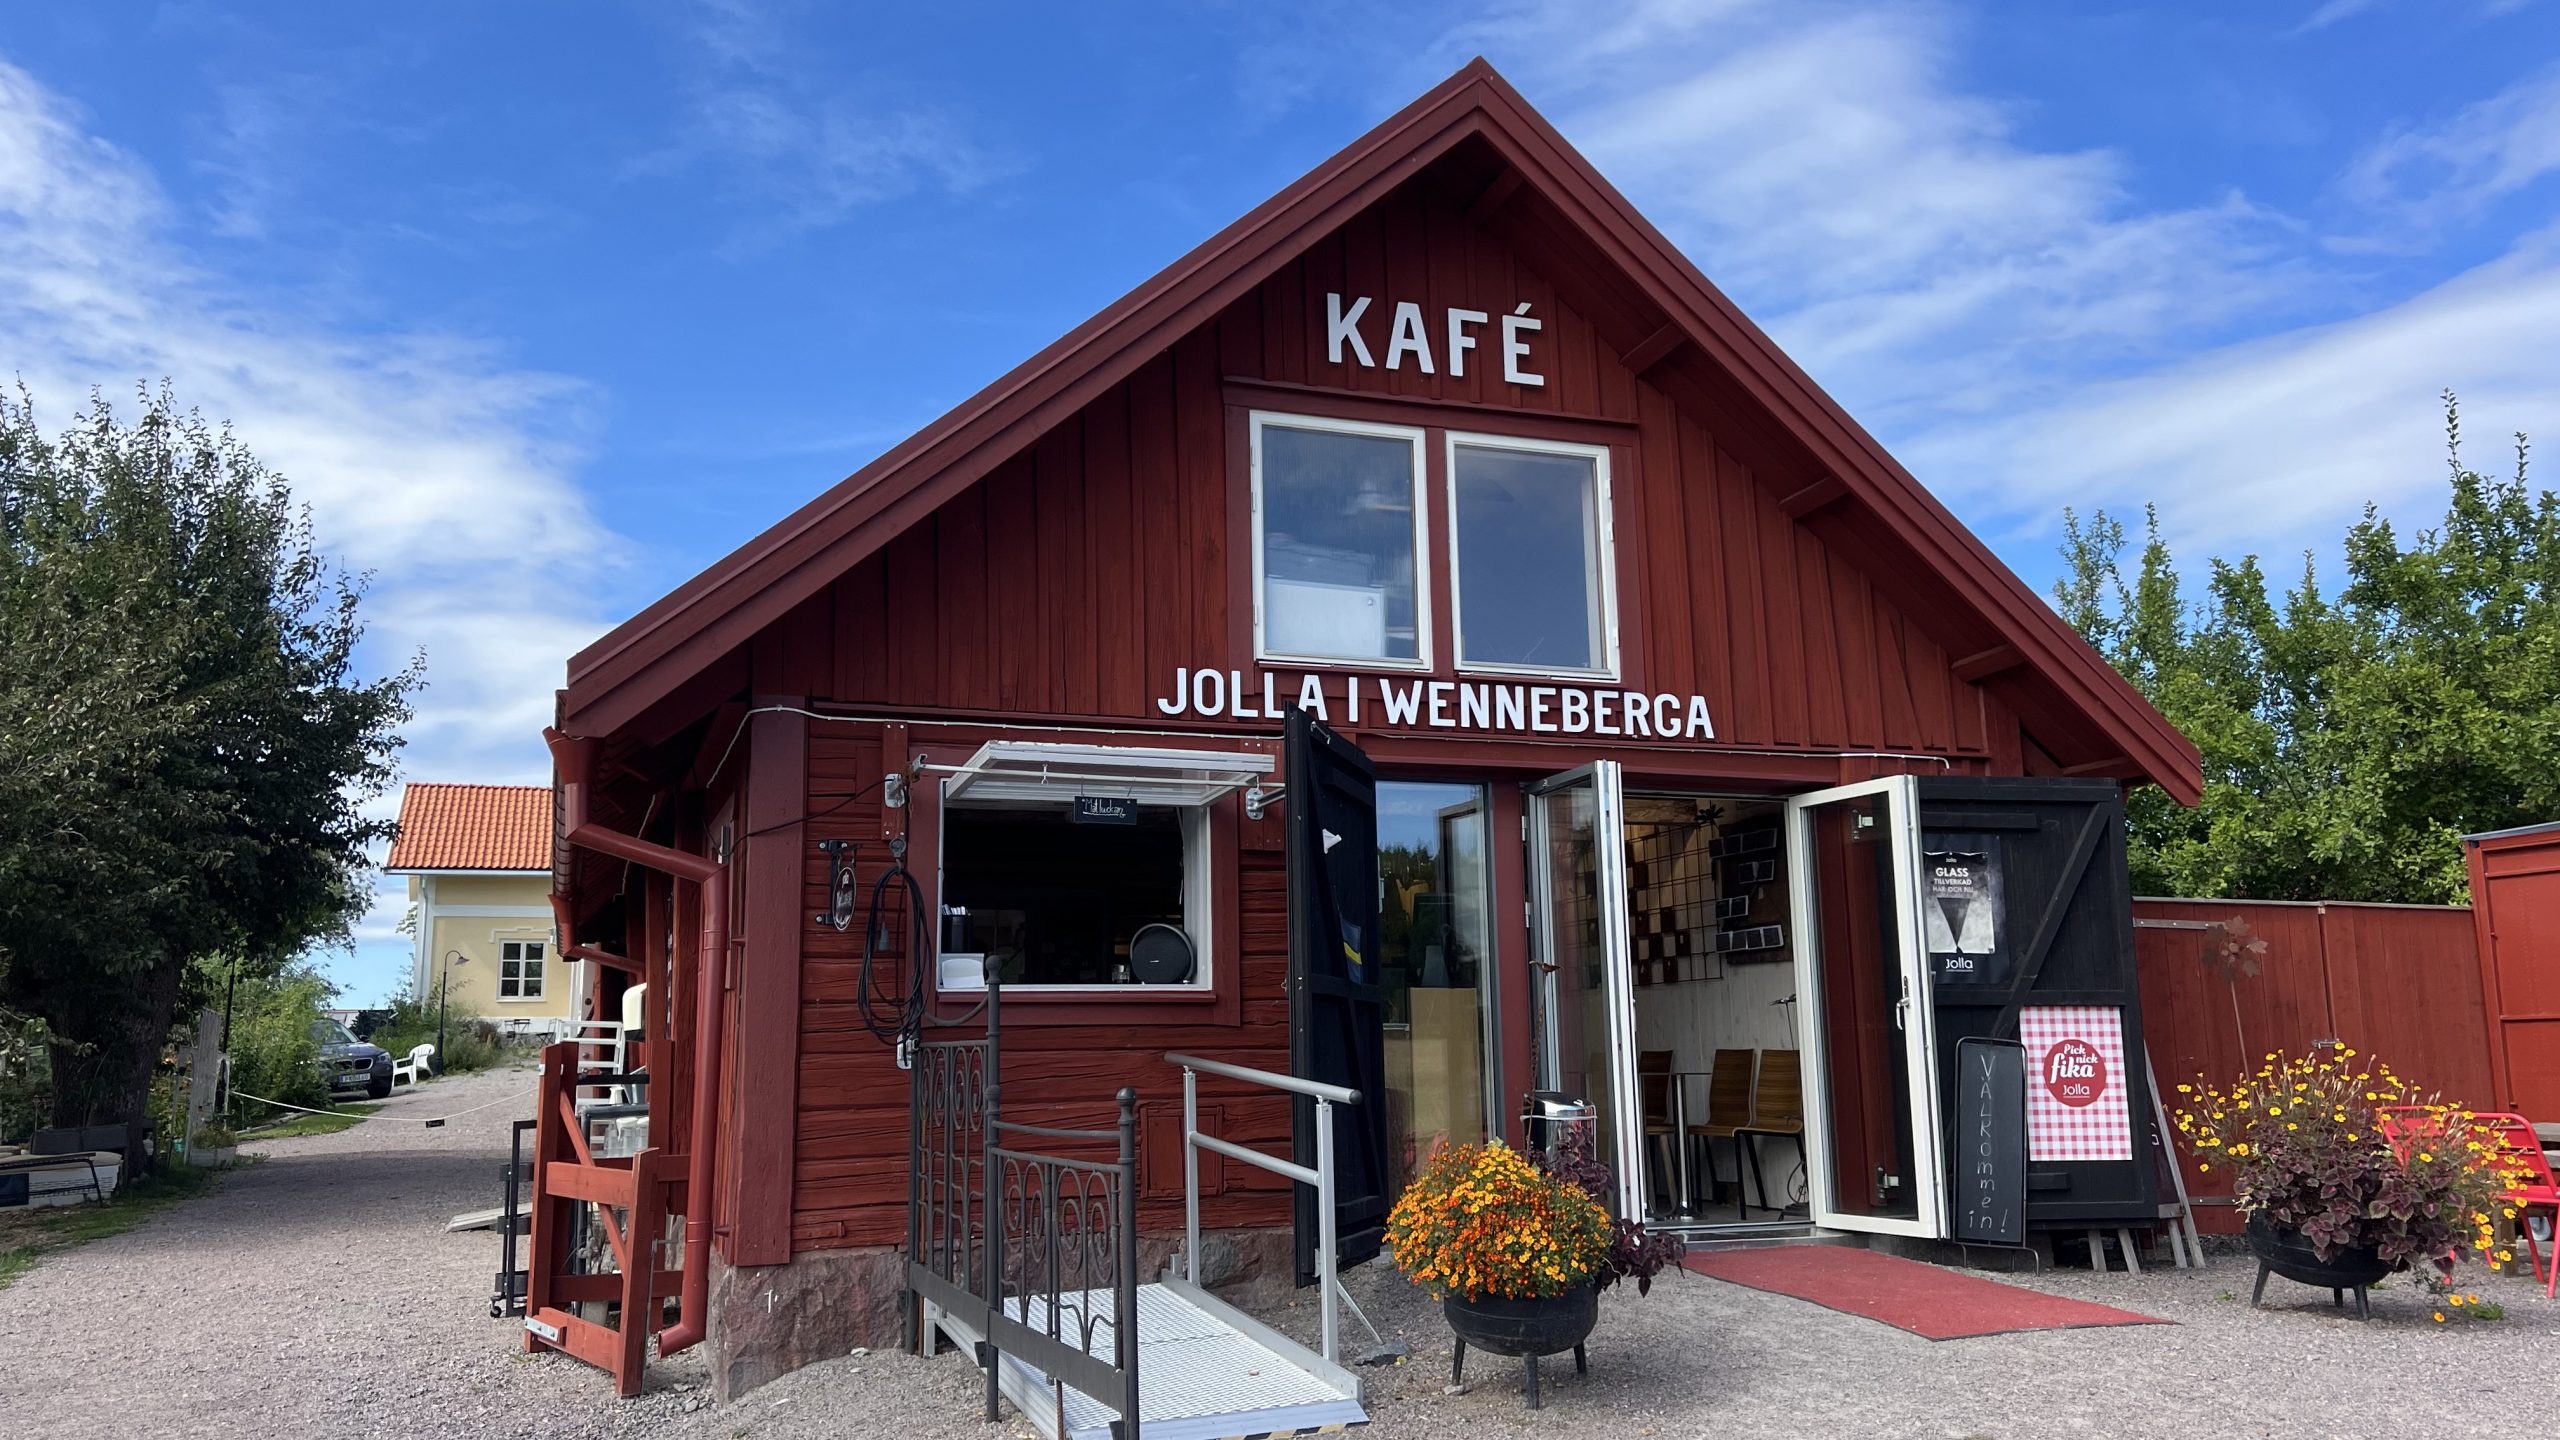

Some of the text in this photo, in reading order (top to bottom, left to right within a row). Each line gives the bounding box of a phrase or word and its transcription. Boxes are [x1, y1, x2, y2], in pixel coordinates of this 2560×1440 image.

[1327, 293, 1544, 386] KAFÉ
[1158, 668, 1715, 739] JOLLA I WENNEBERGA
[1935, 867, 1969, 877] GLASS
[1933, 878, 1972, 886] TILLVERKAD
[1945, 957, 1973, 969] Jolla
[2064, 1044, 2086, 1054] Pick
[2076, 1053, 2098, 1063] nick
[2050, 1053, 2095, 1084] fika
[2063, 1084, 2090, 1095] Jolla
